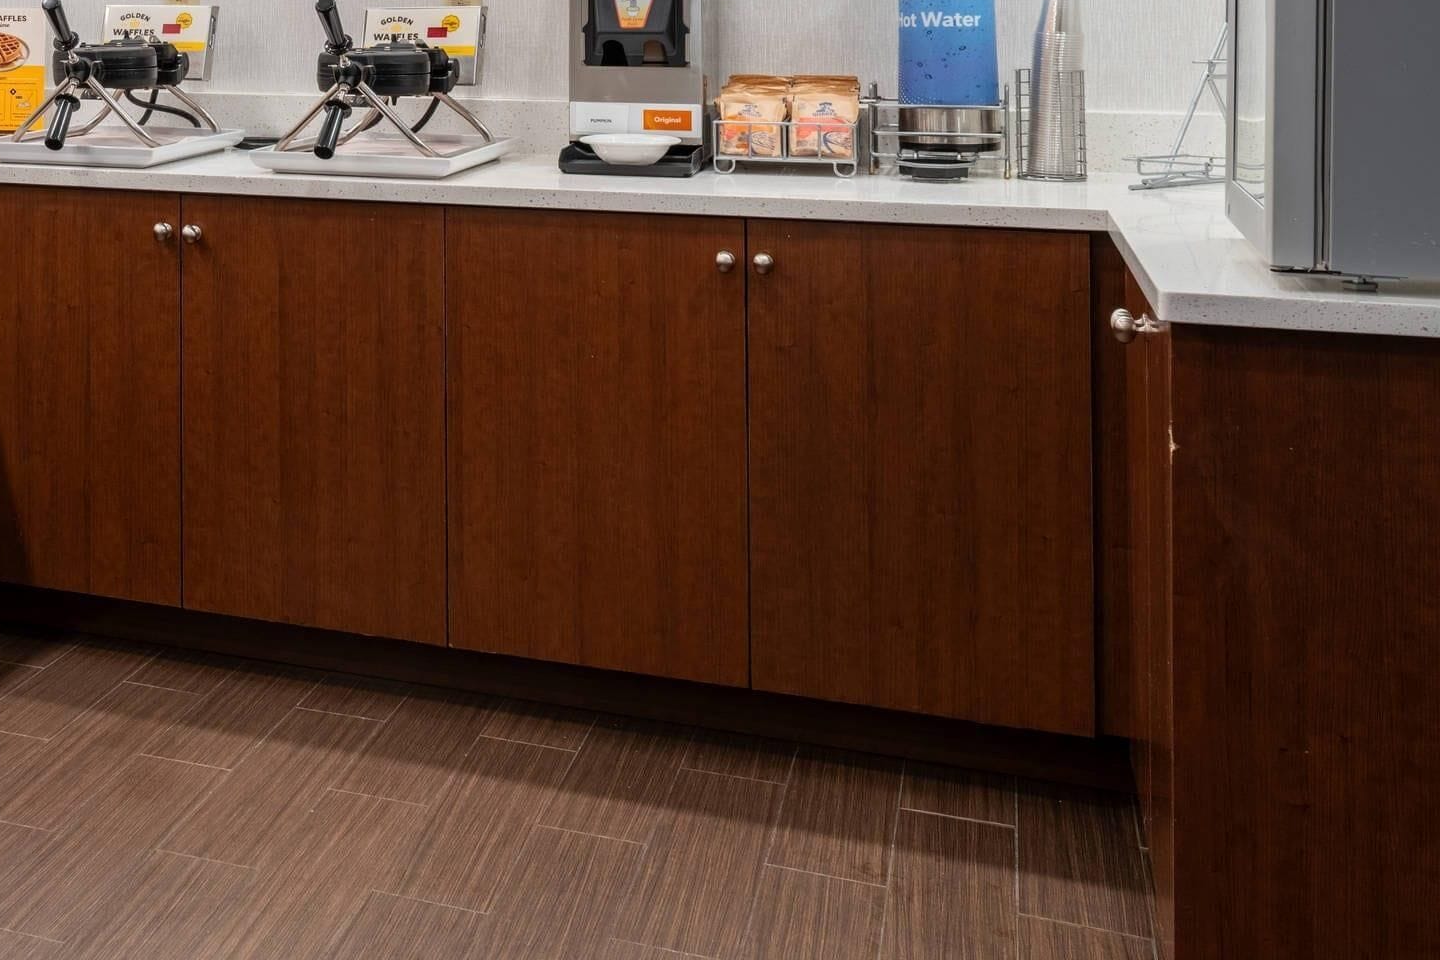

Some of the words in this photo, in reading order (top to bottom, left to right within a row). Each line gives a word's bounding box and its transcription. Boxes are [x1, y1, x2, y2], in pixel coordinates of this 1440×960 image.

[120, 12, 151, 22] GOLDEN
[380, 16, 414, 26] GOLDEN
[920, 11, 982, 28] Water
[654, 116, 681, 125] Original
